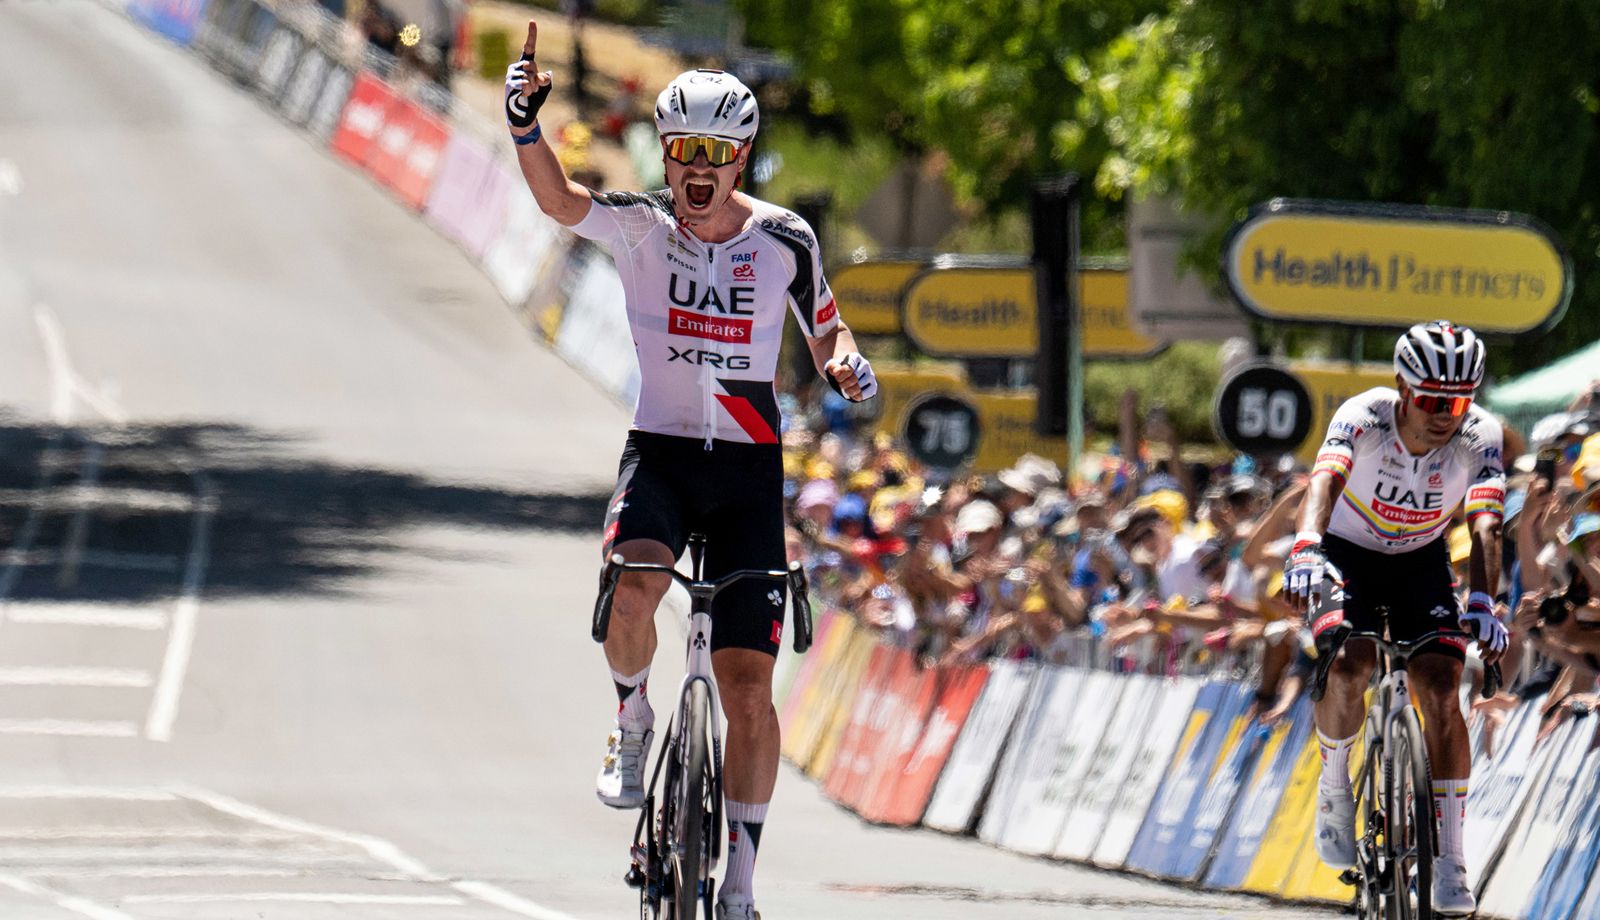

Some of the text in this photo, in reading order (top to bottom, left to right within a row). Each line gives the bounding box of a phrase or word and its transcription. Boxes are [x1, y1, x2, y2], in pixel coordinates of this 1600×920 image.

[670, 85, 680, 115] MET
[722, 89, 739, 120] MET
[773, 222, 815, 250] Analog
[1253, 247, 1546, 300] Health Partners
[668, 272, 755, 315] UAE
[676, 316, 745, 338] Emirates
[667, 346, 750, 370] XRG
[1236, 388, 1298, 439] 50
[916, 410, 970, 452] 75
[1374, 481, 1443, 509] UAE
[1377, 503, 1436, 521] Emirates
